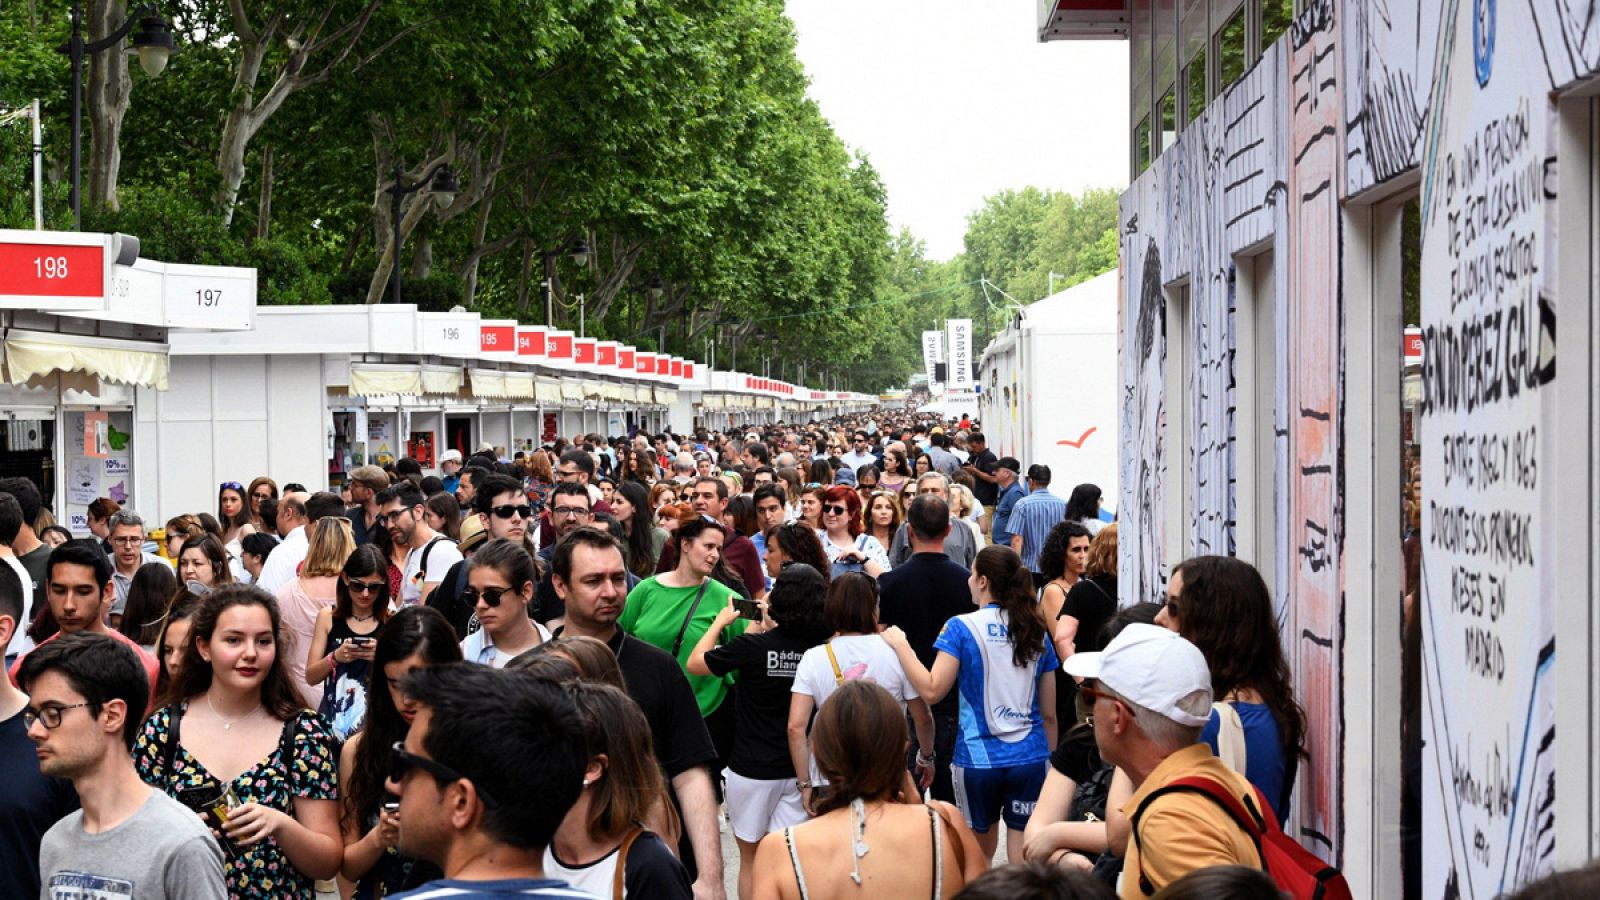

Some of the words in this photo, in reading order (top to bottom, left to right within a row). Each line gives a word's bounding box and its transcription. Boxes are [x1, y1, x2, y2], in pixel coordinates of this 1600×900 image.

[34, 256, 68, 279] 198
[196, 289, 222, 307] 197
[442, 327, 459, 340] 196
[481, 333, 497, 345] 195
[955, 326, 966, 383] SAMSUNG
[1465, 626, 1505, 682] MADRID
